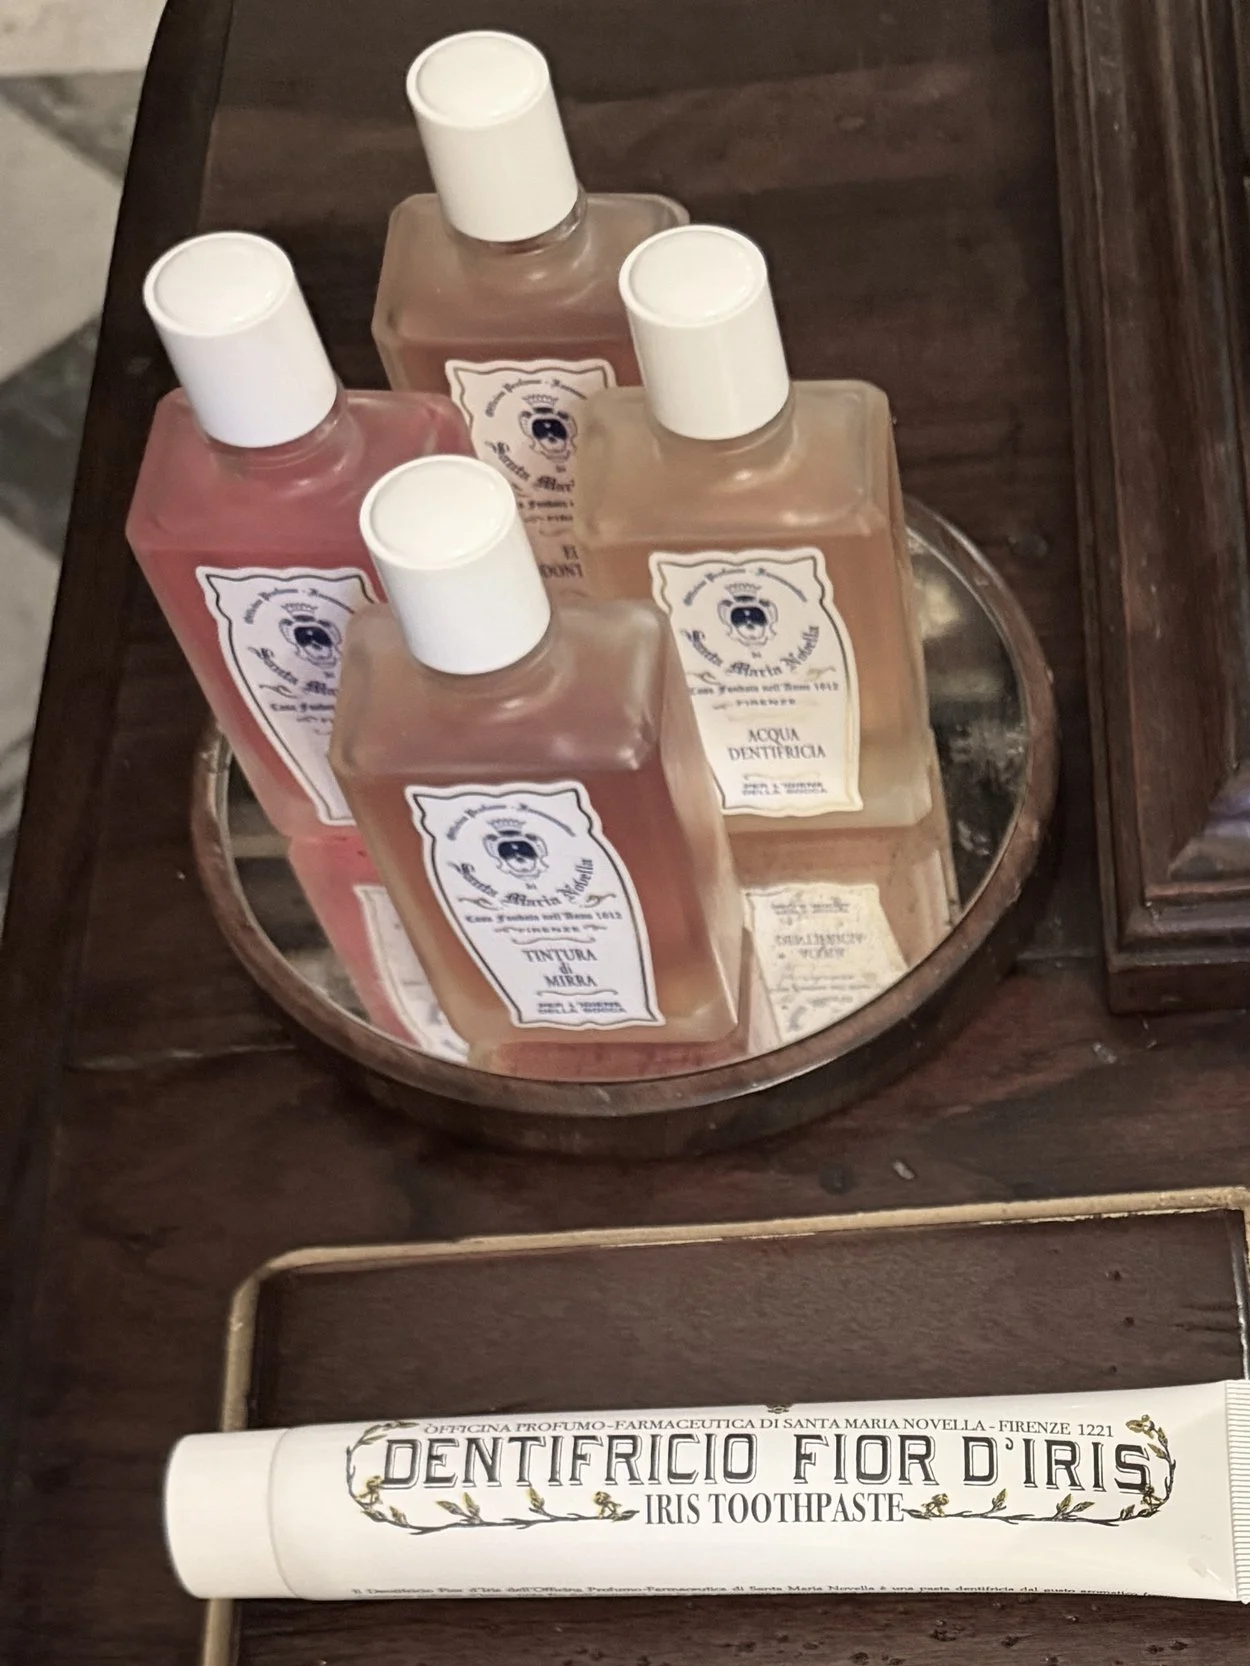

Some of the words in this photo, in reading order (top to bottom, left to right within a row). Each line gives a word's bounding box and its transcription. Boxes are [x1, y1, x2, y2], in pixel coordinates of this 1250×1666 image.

[724, 660, 783, 679] Maria
[748, 727, 801, 745] ACQUA
[728, 745, 827, 762] DENTIFRICIA
[447, 859, 499, 899] Santa
[499, 891, 564, 909] Maria
[556, 857, 594, 902] Novella
[521, 948, 599, 963] TINTURA
[558, 962, 574, 976] di
[544, 975, 599, 988] MIRRA
[423, 1423, 512, 1436] OFFICINA
[515, 1418, 757, 1433] PROFUMO-FARMACEUTICA
[759, 1418, 780, 1430] DI
[781, 1418, 841, 1430] SANTA
[843, 1418, 900, 1430] MARIA
[903, 1418, 987, 1431] NOVELLA
[998, 1420, 1072, 1436] FIRENZE
[1076, 1422, 1115, 1438] 1221
[381, 1433, 758, 1490] DENTIFRICIO
[793, 1433, 940, 1487] FIOR
[962, 1435, 1152, 1495] D'IRIS
[644, 1492, 702, 1526] IRIS
[707, 1492, 906, 1526] TOOTHPASTE
